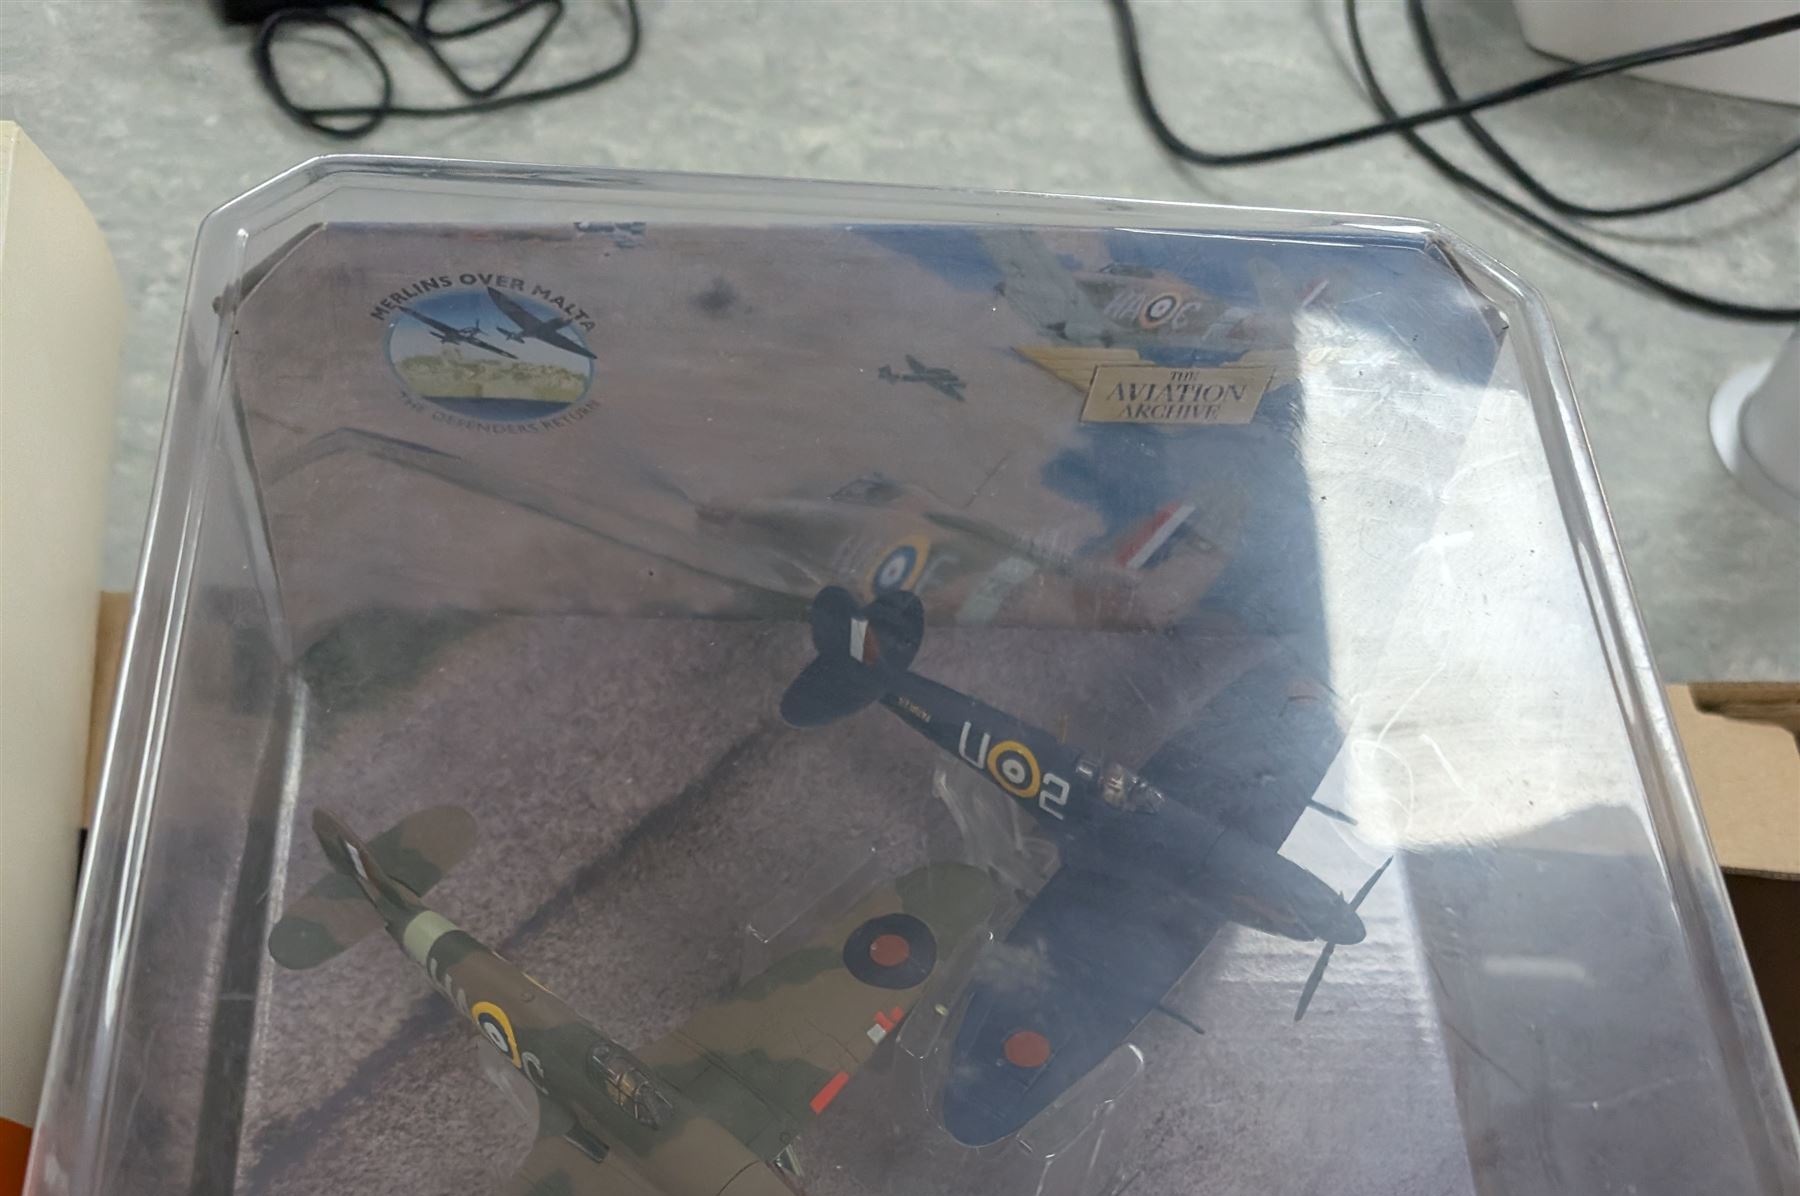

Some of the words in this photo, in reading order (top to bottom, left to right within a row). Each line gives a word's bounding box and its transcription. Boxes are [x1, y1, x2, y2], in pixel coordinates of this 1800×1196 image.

[370, 275, 452, 320] MERLINS
[459, 272, 525, 291] OVER
[531, 284, 596, 332] MALTA
[1170, 370, 1197, 382] THE
[1107, 381, 1247, 401] AVIATION
[542, 401, 600, 430] RETURN
[1119, 403, 1220, 419] ARCHIVE
[958, 721, 990, 769] U
[1039, 773, 1070, 820] 2
